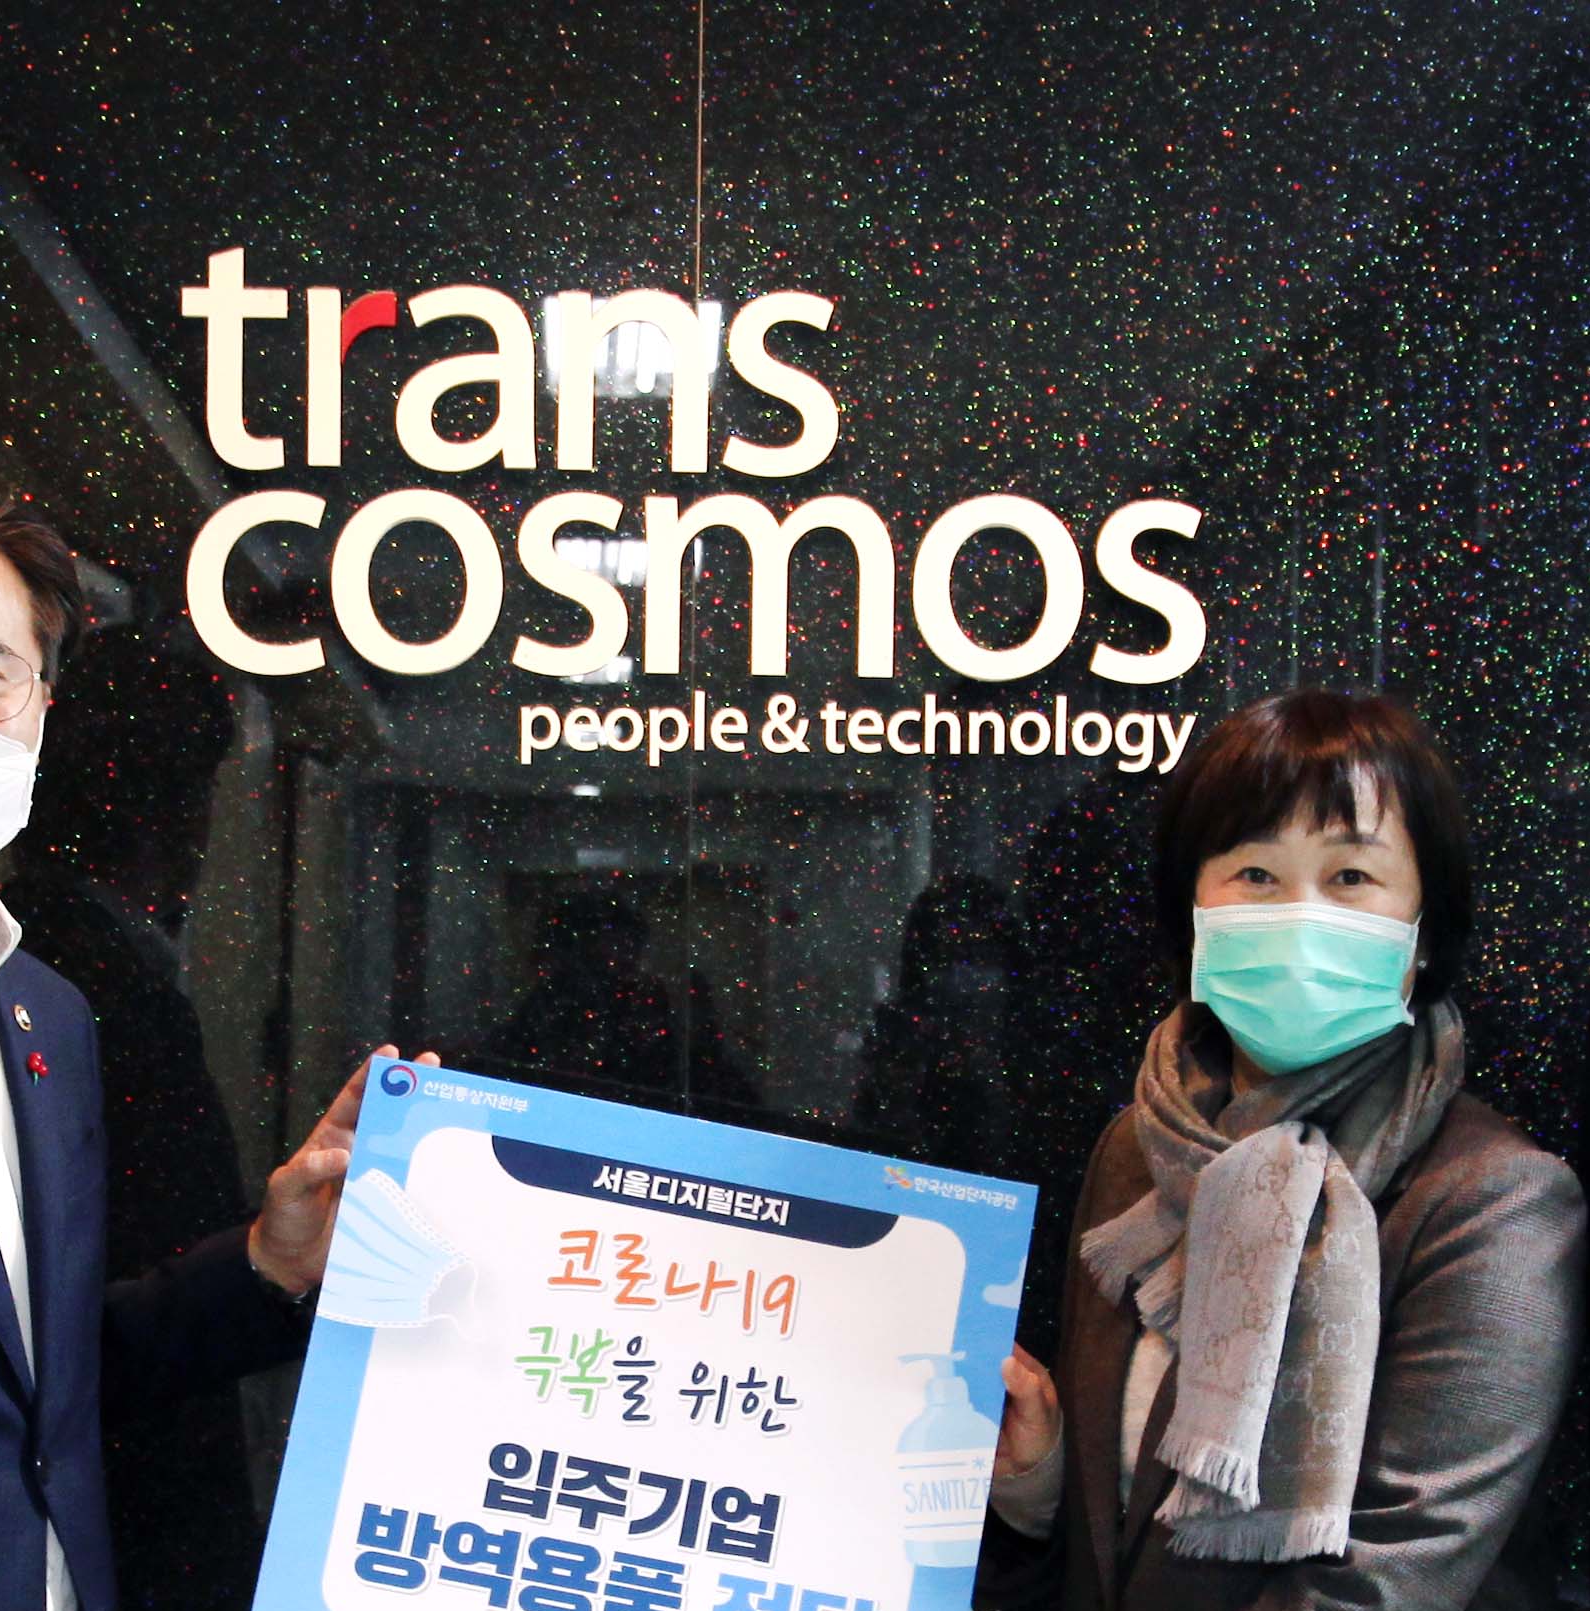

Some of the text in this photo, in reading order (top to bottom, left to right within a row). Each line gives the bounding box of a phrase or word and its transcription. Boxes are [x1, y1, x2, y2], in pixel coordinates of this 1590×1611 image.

[181, 247, 840, 478] trans
[186, 487, 1207, 685] cosmos
[519, 689, 1196, 774] people & technology
[592, 1164, 792, 1227] 서울디지털단지
[547, 1230, 796, 1335] 코로나19
[514, 1327, 798, 1432] 극복을 위한
[481, 1441, 783, 1563] 입주기업
